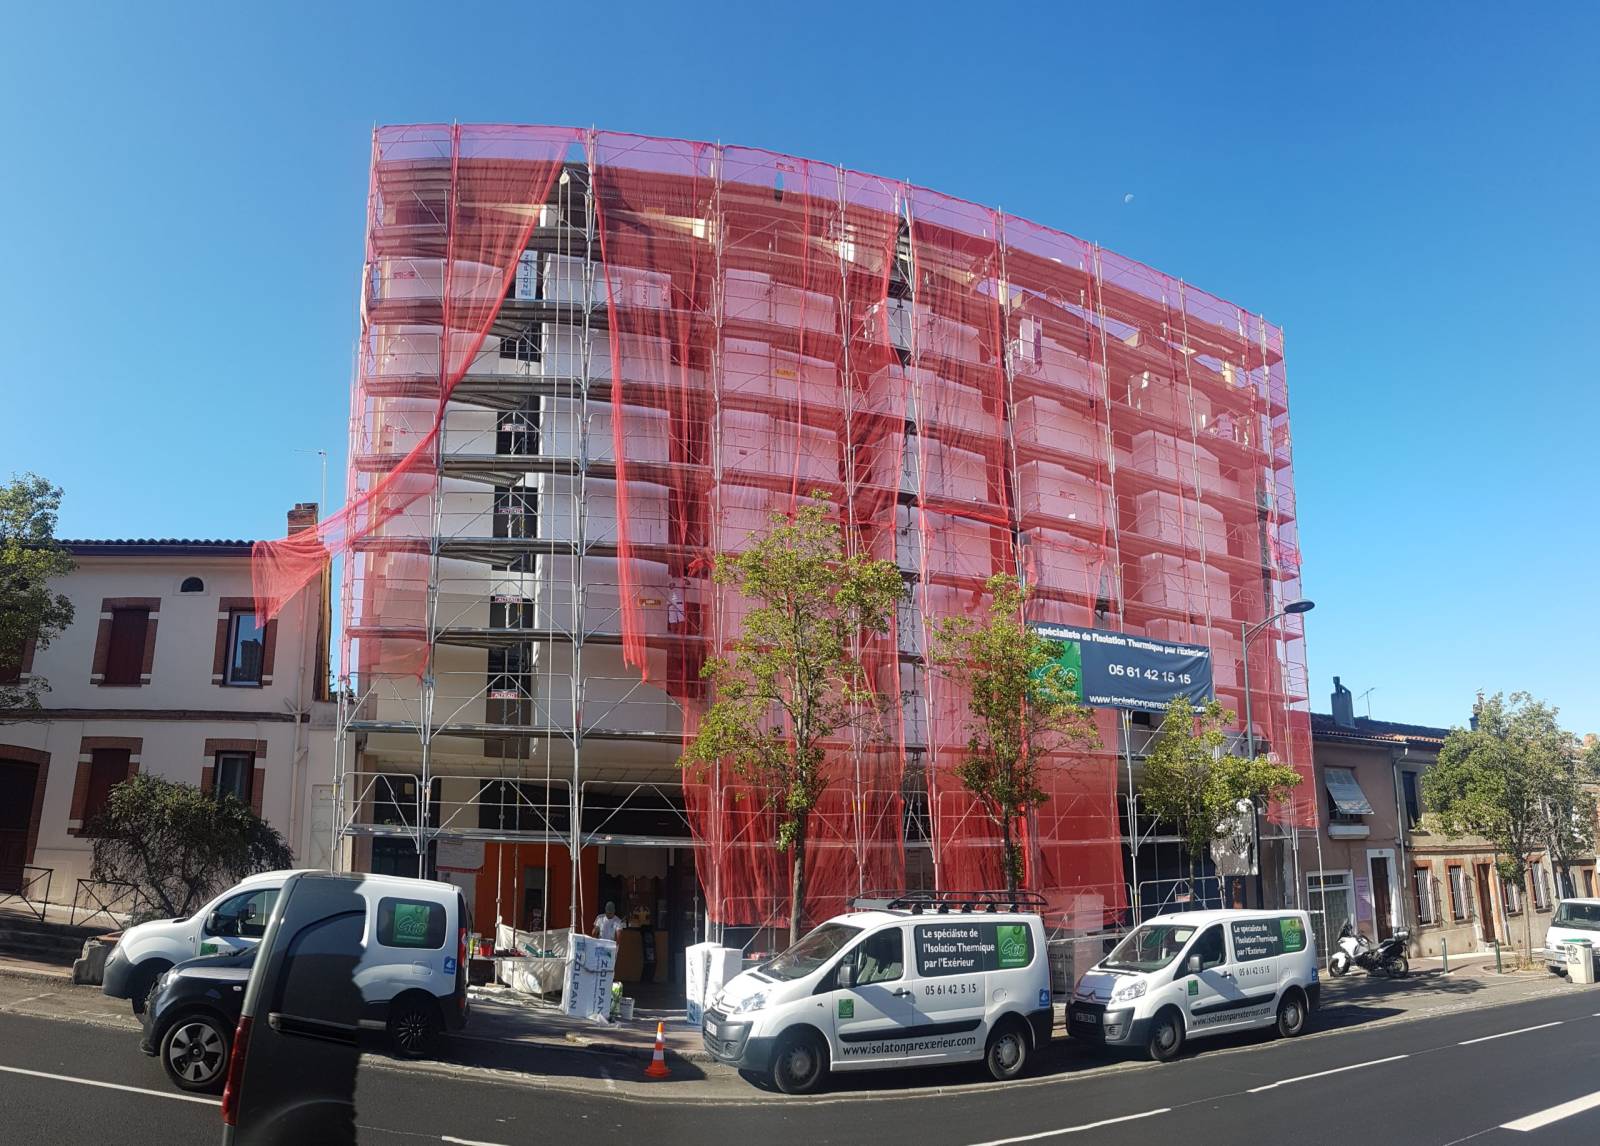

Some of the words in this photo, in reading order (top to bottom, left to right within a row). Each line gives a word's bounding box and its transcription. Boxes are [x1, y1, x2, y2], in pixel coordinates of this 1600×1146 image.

[1081, 632, 1092, 642] de
[1127, 638, 1164, 653] Thermique
[1164, 645, 1176, 656] par
[1108, 663, 1125, 676] 05
[1126, 667, 1141, 678] 61
[1143, 669, 1159, 681] 42
[1162, 671, 1175, 683] 15
[1178, 673, 1192, 685] 15
[922, 929, 933, 938] Le
[969, 928, 978, 938] de
[1233, 925, 1240, 933] Le
[957, 942, 995, 955] Thermique
[924, 959, 937, 970] par
[1239, 967, 1245, 976] 05
[1252, 966, 1259, 975] 42
[569, 952, 582, 1009] ZOLPAN
[925, 984, 935, 995] 05
[937, 984, 946, 995] 61
[948, 984, 957, 995] 42
[968, 983, 977, 993] 15
